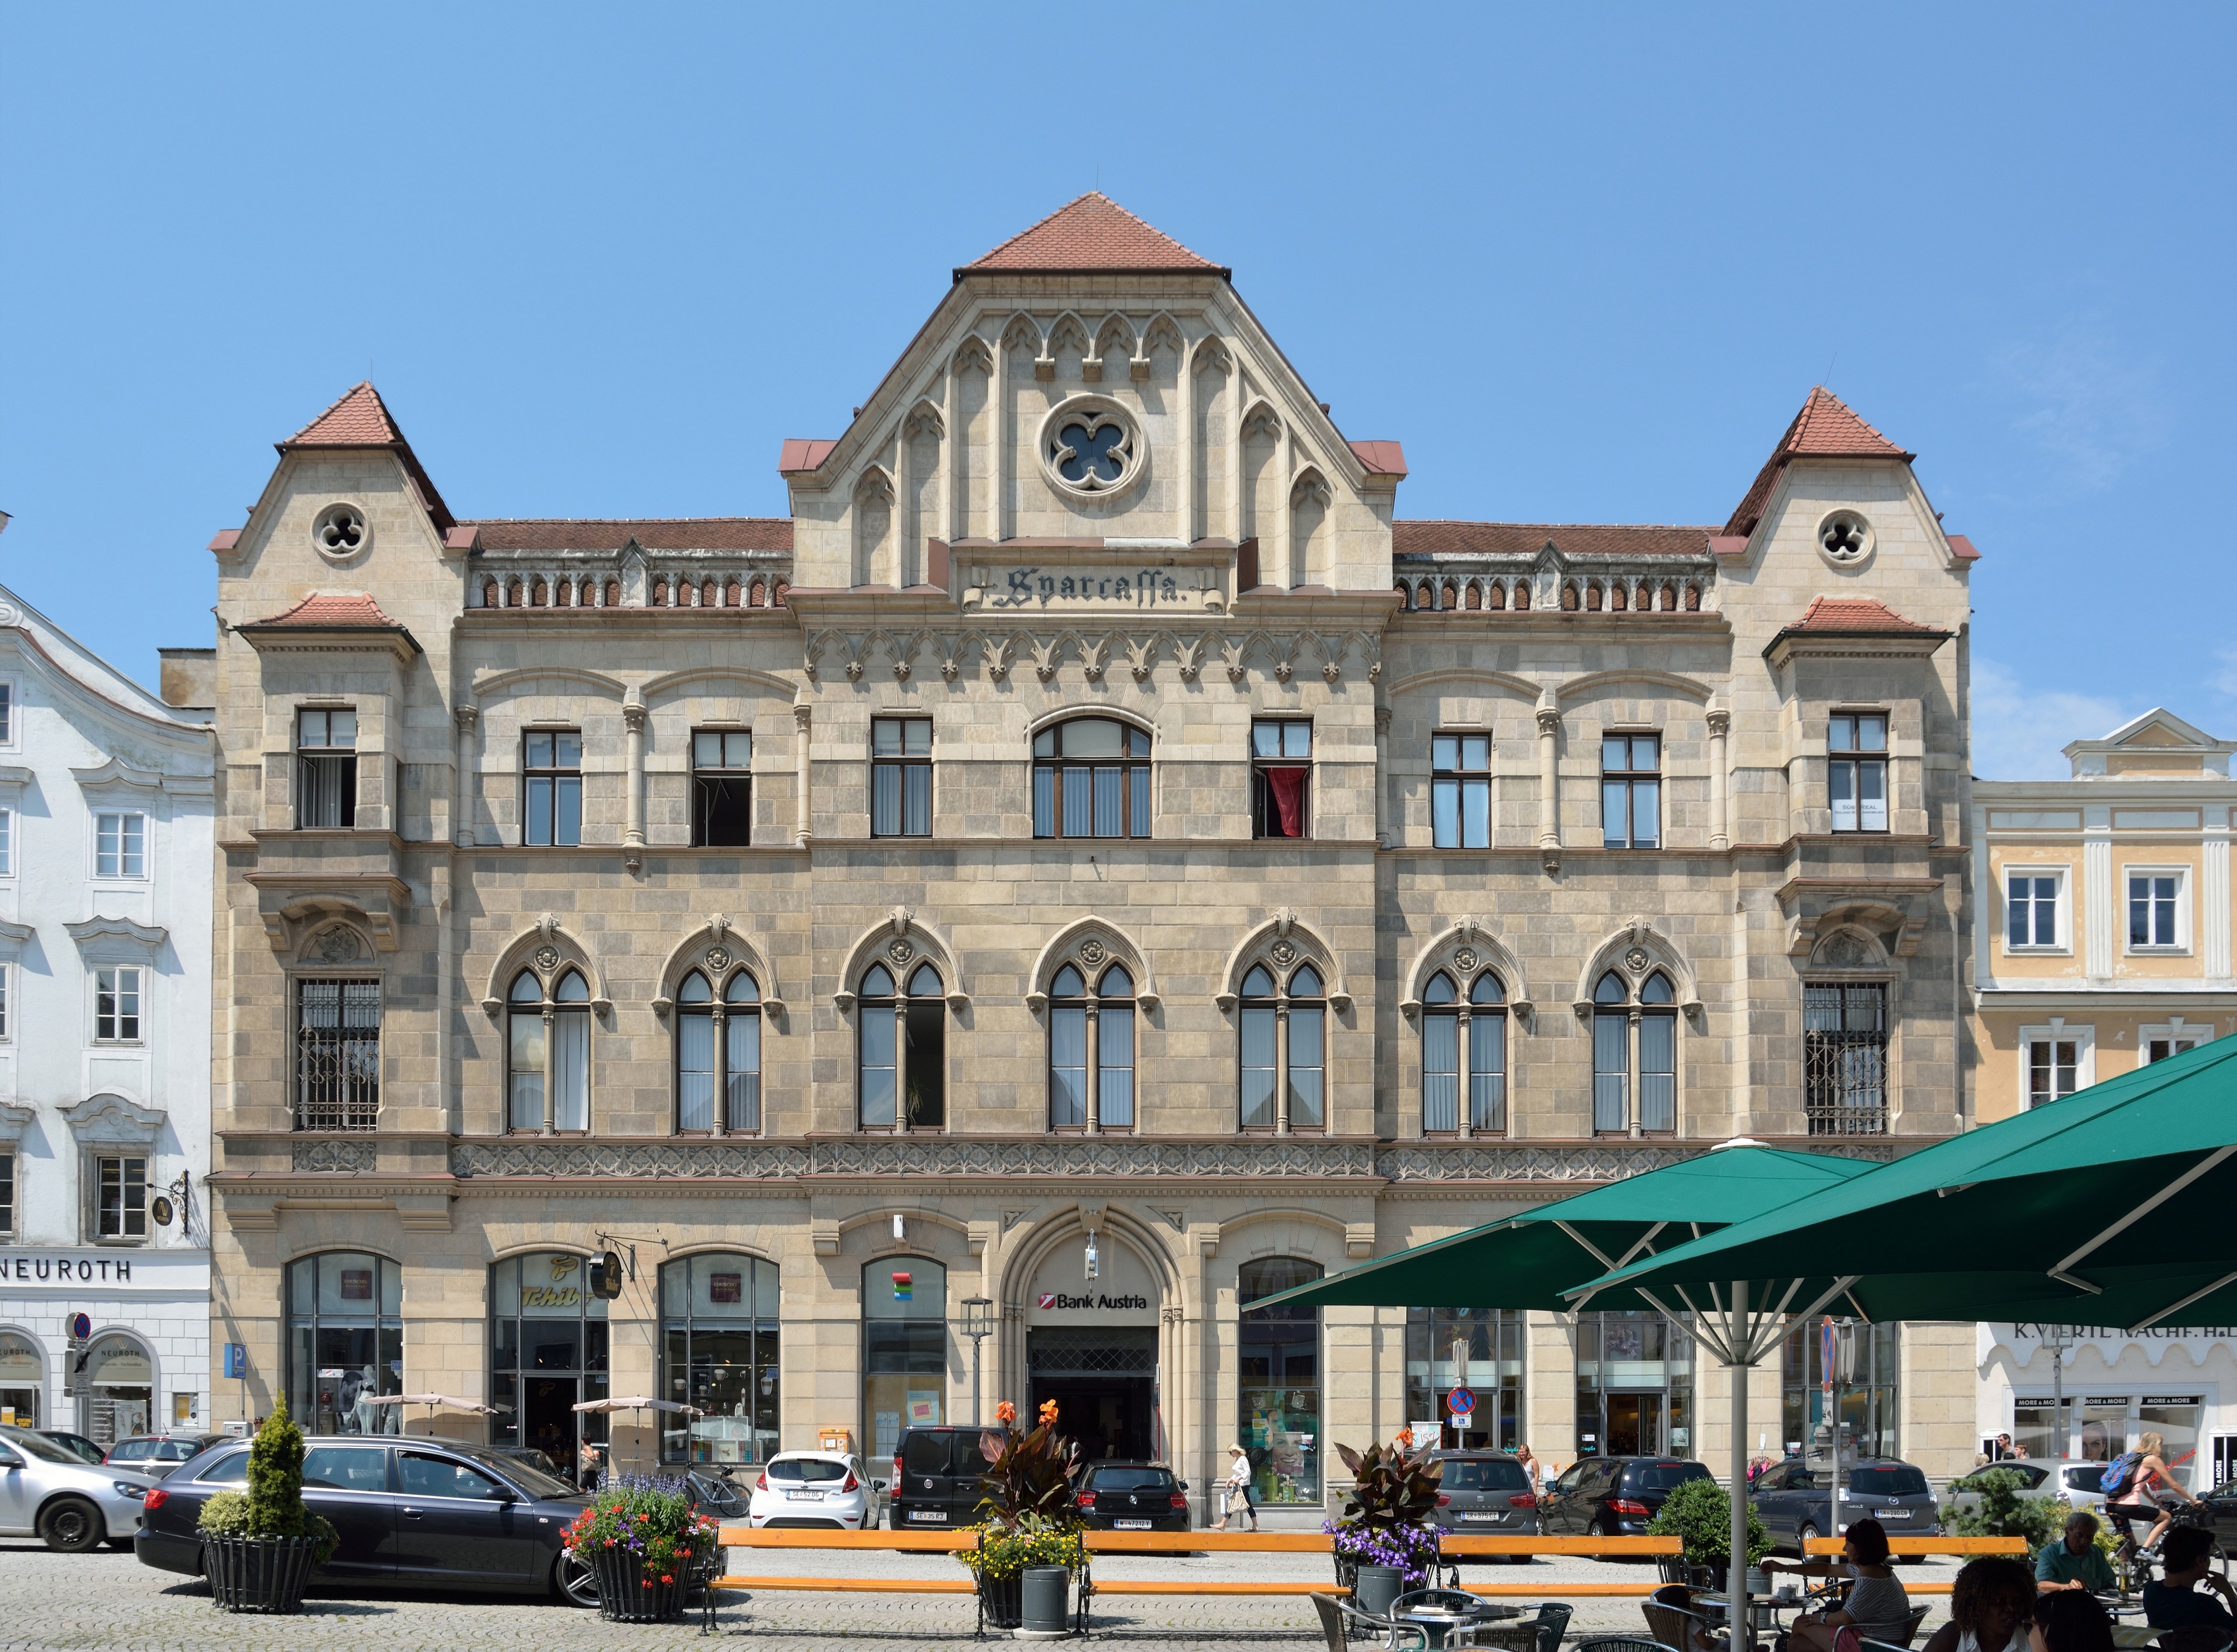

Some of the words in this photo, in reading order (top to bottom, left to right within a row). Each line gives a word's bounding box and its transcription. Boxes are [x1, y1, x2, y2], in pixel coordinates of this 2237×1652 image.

[0, 1259, 129, 1280] NEUROTH
[1058, 1294, 1094, 1309] Bank
[1098, 1294, 1146, 1309] Austria
[234, 1347, 243, 1366] P
[2165, 1460, 2179, 1471] ALE
[2178, 1448, 2197, 1463] SALE
